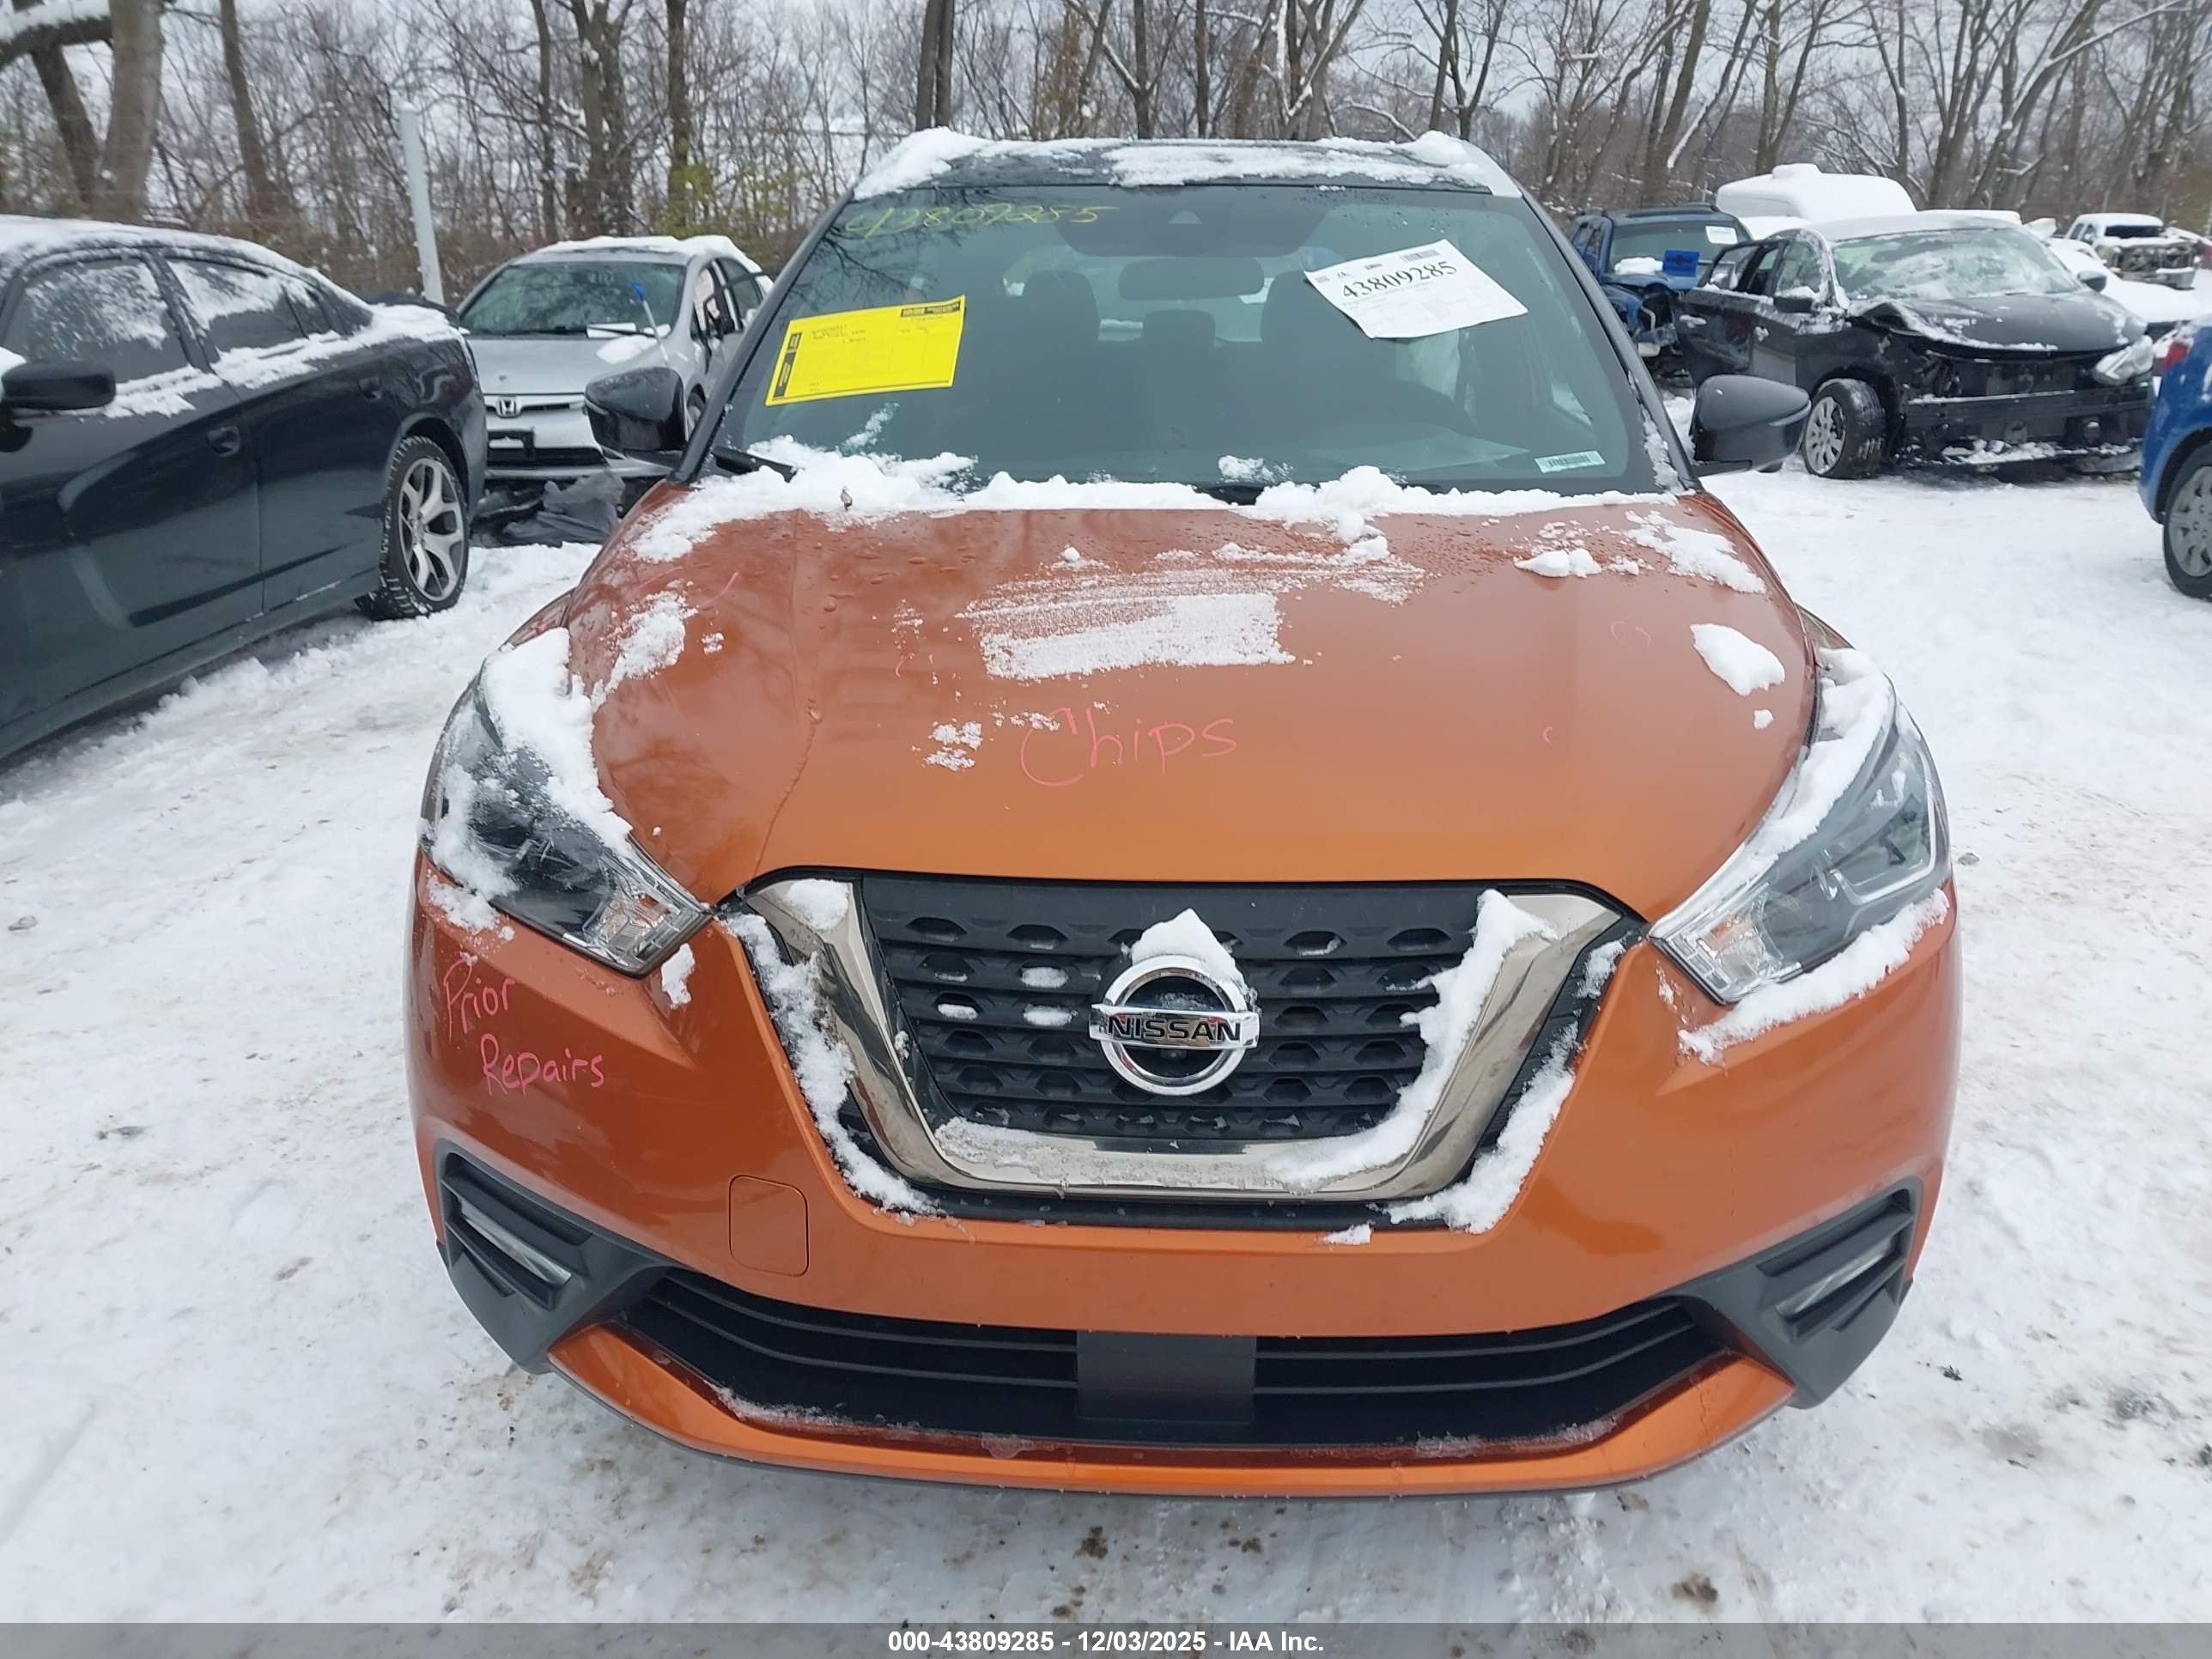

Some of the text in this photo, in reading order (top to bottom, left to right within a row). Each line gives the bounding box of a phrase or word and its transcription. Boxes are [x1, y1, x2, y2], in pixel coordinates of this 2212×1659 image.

[1342, 260, 1458, 298] 43809285
[1020, 706, 1237, 787] Chips
[443, 957, 516, 1044] Prior
[1108, 1013, 1241, 1042] NISSAN
[481, 1033, 605, 1097] Repairs
